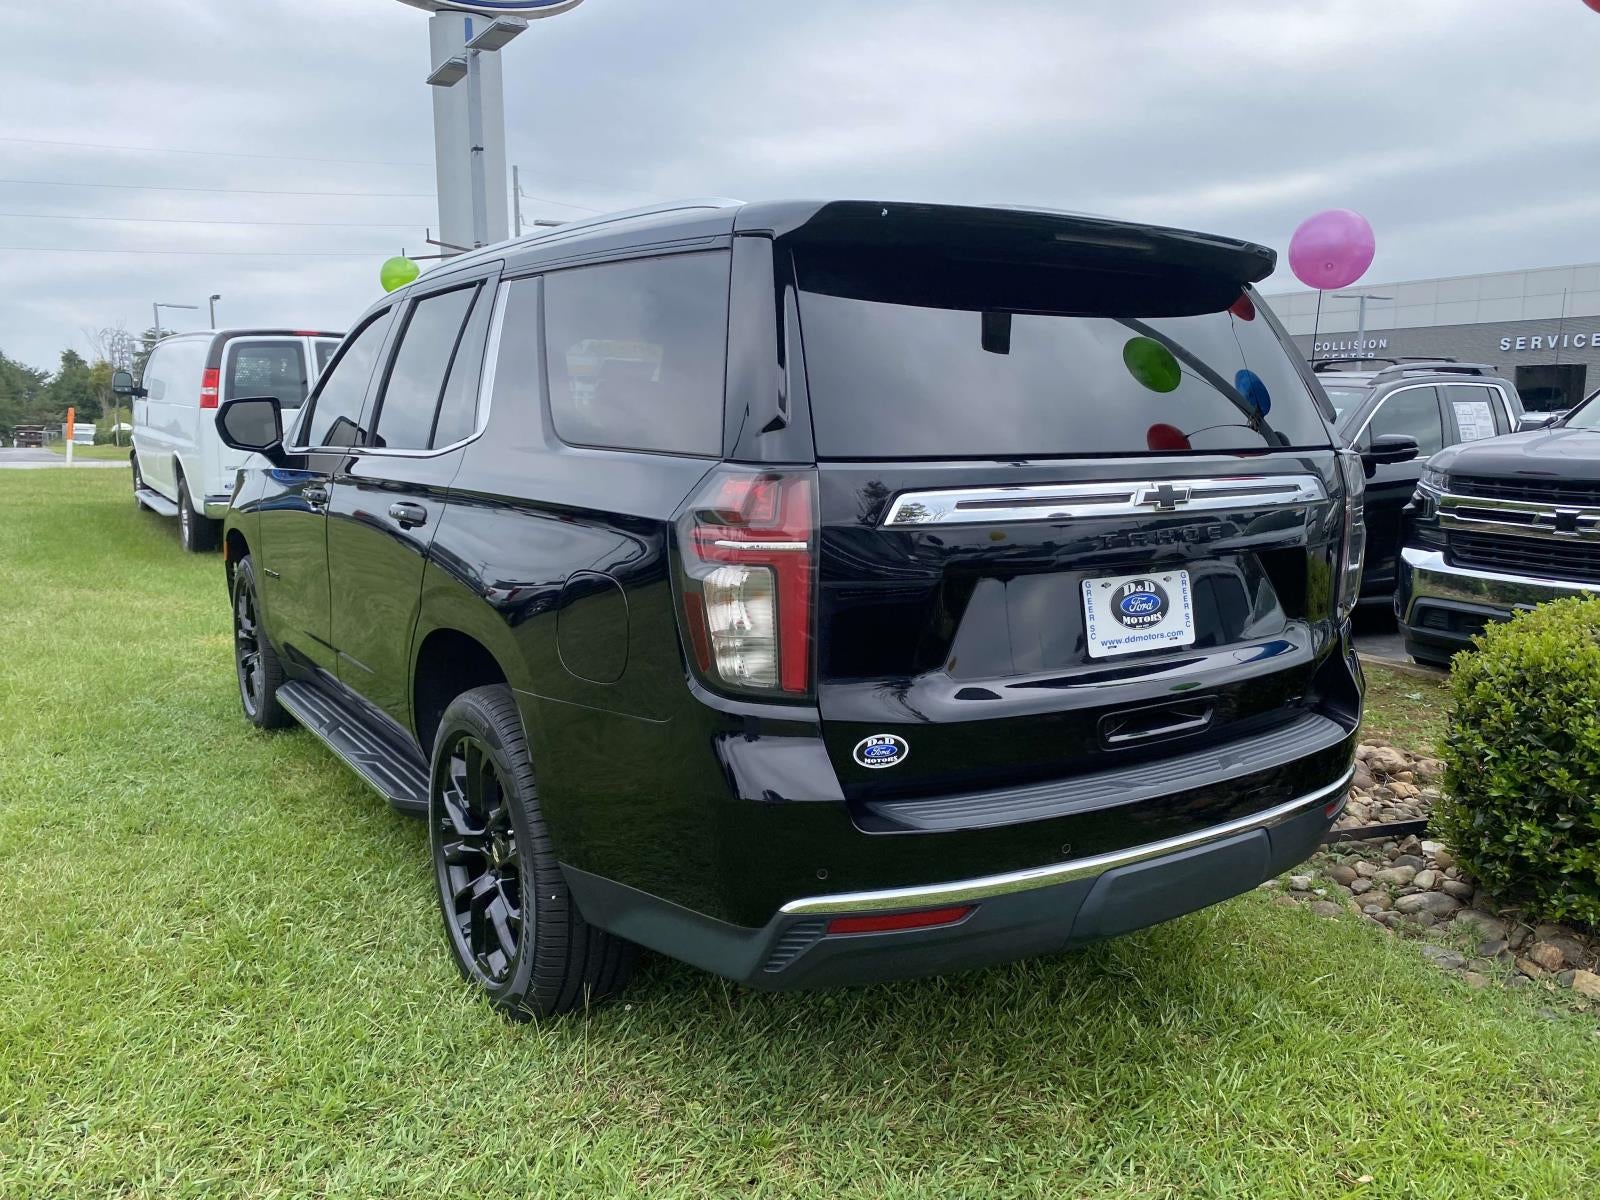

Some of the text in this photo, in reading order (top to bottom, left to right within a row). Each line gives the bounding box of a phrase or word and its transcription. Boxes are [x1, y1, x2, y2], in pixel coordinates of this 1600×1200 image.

[1314, 339, 1387, 351] COLLISION
[1500, 333, 1600, 351] SERVICE
[1122, 580, 1156, 597] D&D
[1128, 596, 1155, 612] Ford
[1122, 611, 1163, 626] MOTORS
[1100, 630, 1184, 648] www.ddmotors.com
[867, 737, 895, 747] D&D
[871, 746, 891, 756] Ford
[864, 755, 898, 764] MOTORS
